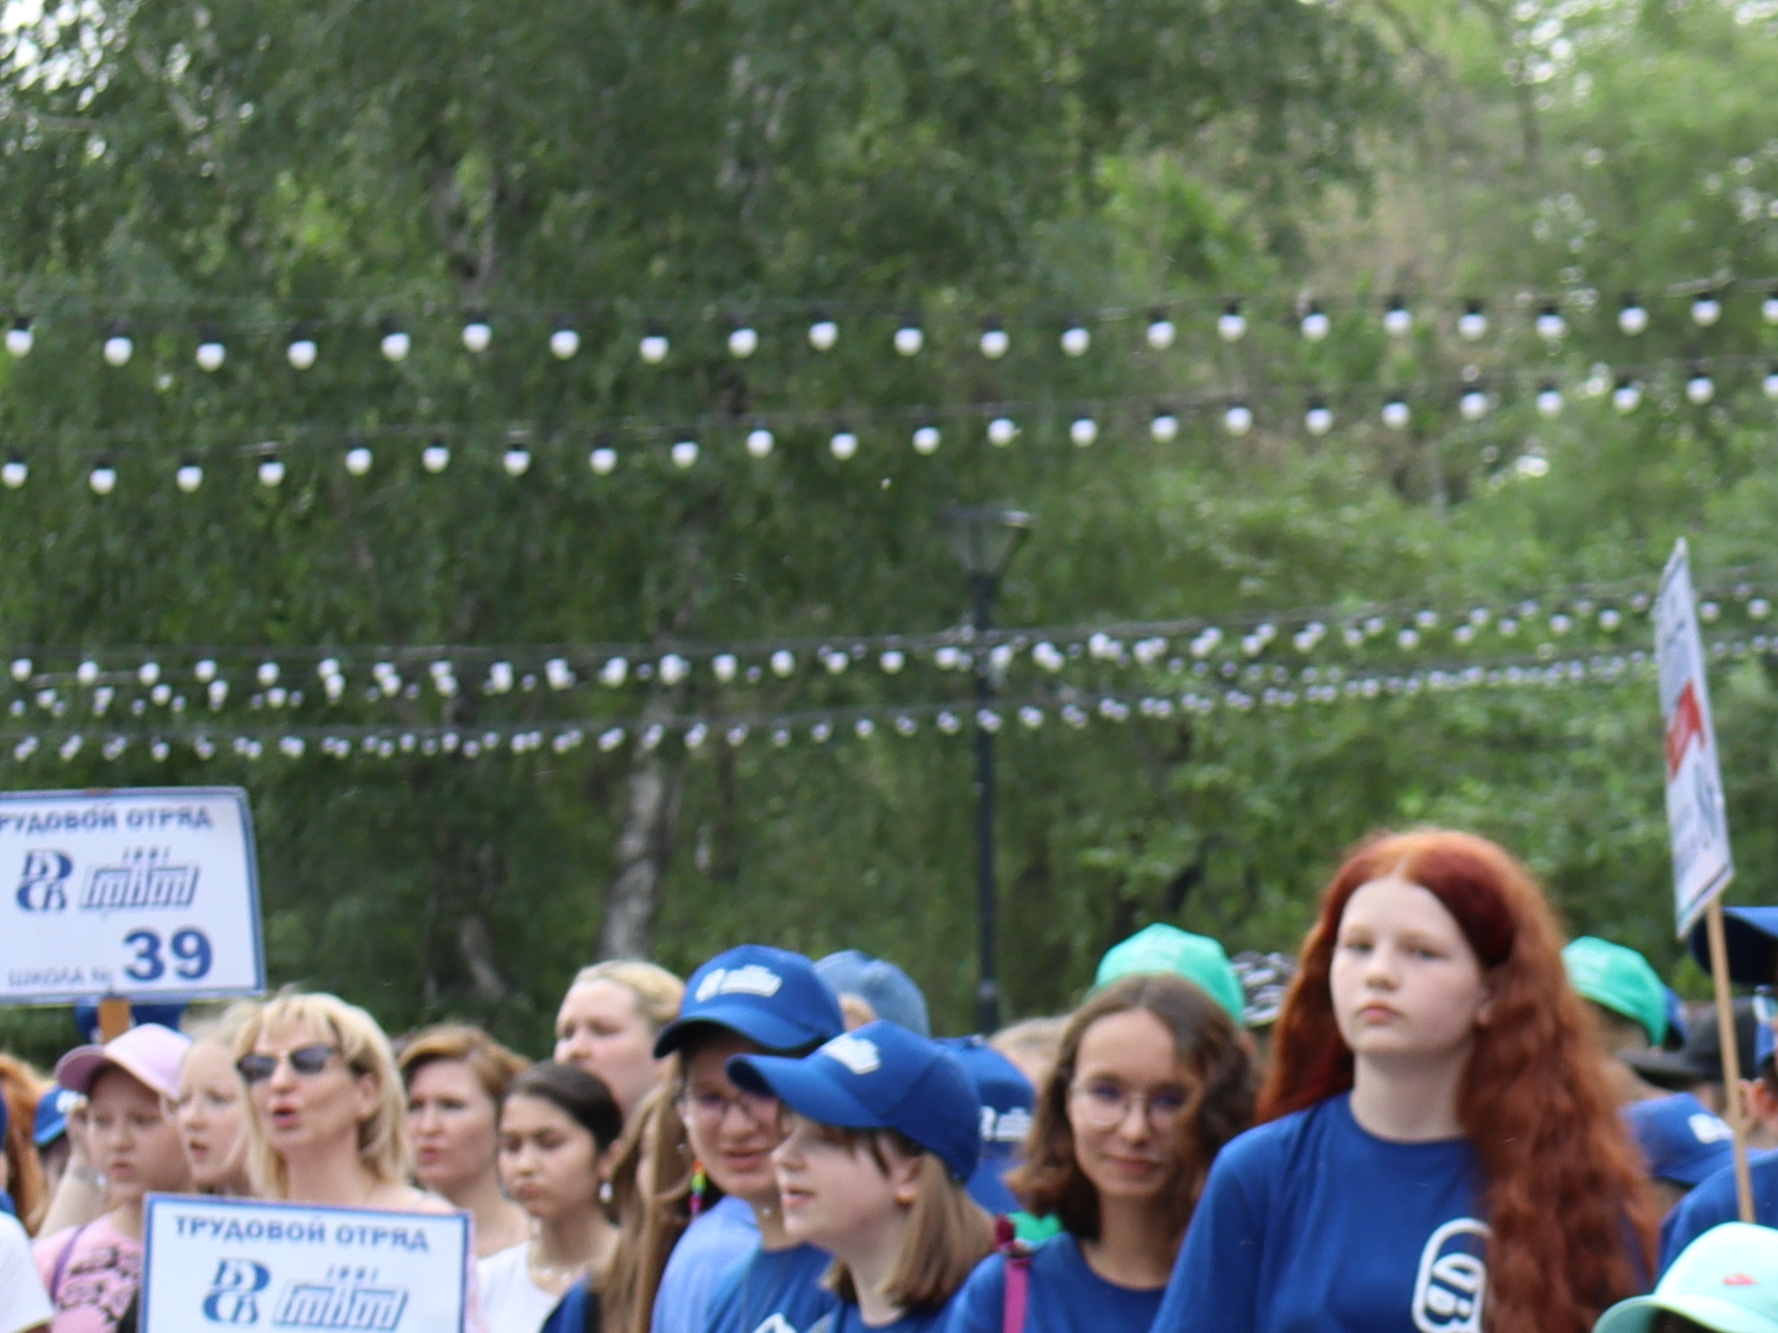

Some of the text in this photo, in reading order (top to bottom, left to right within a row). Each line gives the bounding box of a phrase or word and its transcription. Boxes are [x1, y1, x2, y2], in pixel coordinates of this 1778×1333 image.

[0, 802, 213, 834] РУДОВОЙ ОТРЯД
[123, 926, 214, 984] 39
[175, 1213, 429, 1253] ТРУДОВОЙ ОТРЯД
